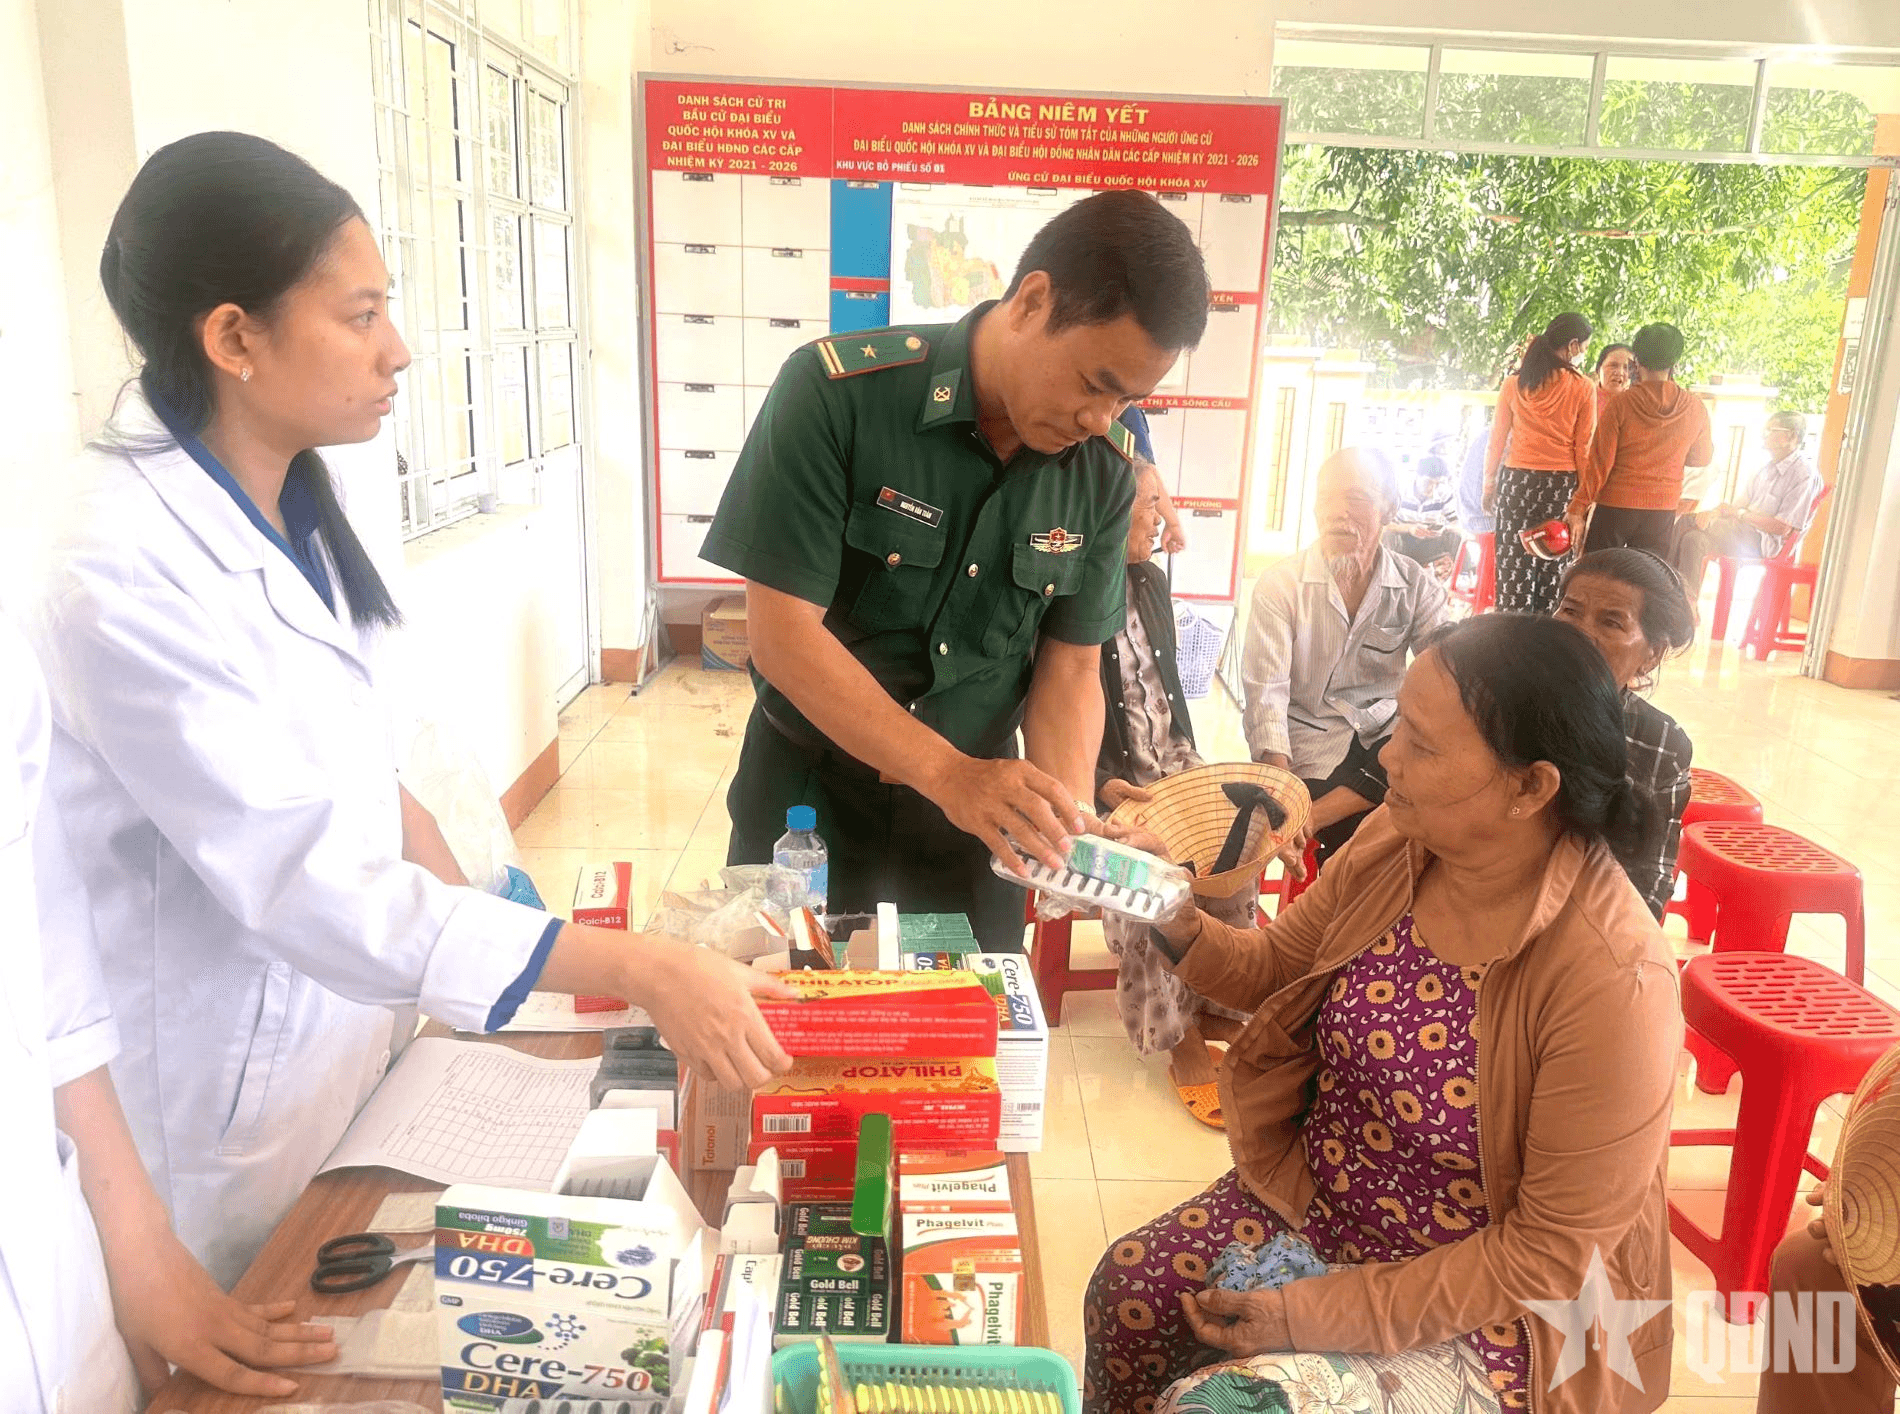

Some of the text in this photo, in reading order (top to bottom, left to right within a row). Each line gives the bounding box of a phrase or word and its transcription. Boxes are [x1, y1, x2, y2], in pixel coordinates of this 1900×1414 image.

[678, 94, 787, 109] DANH SÁCH CỬ TRI
[969, 96, 1150, 125] BẢNG NIÊM YẾT
[710, 108, 727, 122] CỬ
[730, 113, 750, 125] ĐẠI
[754, 109, 781, 125] BIỂU
[668, 123, 796, 141] QUỐC HỘI KHÓA XV VÀ
[902, 119, 1213, 145] DANH SÁCH CHÍNH THỨC VÀ TIỂU SỬ TÓM TẮT CỦA NHỮNG NGƯỜI ỨNG CỬ
[662, 137, 803, 156] ĐẠI BIỂU HĐND CÁC CẤP
[853, 138, 868, 152] ĐẠI
[871, 134, 892, 153] BIỂU
[894, 137, 918, 154] QUỐC
[920, 139, 935, 156] HỘI
[938, 140, 961, 156] KHÓA
[964, 143, 976, 156] XV
[978, 141, 989, 157] VÀ
[991, 144, 1007, 159] ĐẠI
[1009, 140, 1030, 158] BIỂU
[1032, 143, 1047, 160] HỘI
[1050, 143, 1074, 160] ĐỒNG
[1076, 146, 1100, 161] NHÂN
[1102, 147, 1120, 162] DÂN
[1122, 147, 1140, 163] CÁC
[1142, 147, 1160, 163] CẤP
[1162, 150, 1190, 166] NHIỆM
[1192, 151, 1204, 165] KỲ
[1207, 153, 1228, 165] 2021
[1236, 154, 1259, 166] 2026
[667, 155, 705, 168] NHIỆM
[709, 156, 724, 169] KỲ
[728, 159, 757, 170] 2021
[768, 161, 798, 172] 2026
[836, 159, 945, 173] KHU VỰC BỎ PHIẾU SỐ 01
[1008, 170, 1208, 188] ỨNG CỬ ĐẠI BIỂU QUỐC HỘI KHÓA XV
[579, 916, 621, 926] Calci-B12
[784, 979, 899, 987] PHILATOP
[1002, 957, 1033, 1025] Cere-750
[995, 995, 1012, 1022] DHA
[842, 1065, 963, 1079] PHILATOP
[931, 1181, 997, 1193] Phagelvit
[458, 1212, 528, 1228] Ginkgo biloba
[797, 1207, 809, 1236] Gold Bell
[916, 1219, 984, 1229] Phagelvit
[484, 1224, 528, 1237] 750mg
[459, 1233, 526, 1254] DHA
[791, 1249, 804, 1280] Gold Bell
[449, 1255, 652, 1300] Cere-750
[810, 1279, 859, 1290] Gold Bell
[787, 1293, 800, 1327] Gold Bell
[815, 1311, 827, 1327] Bell
[843, 1296, 855, 1326] old Bell
[870, 1294, 883, 1327] Gold Bell
[460, 1341, 652, 1392] Cere-750
[463, 1371, 544, 1398] DHA
